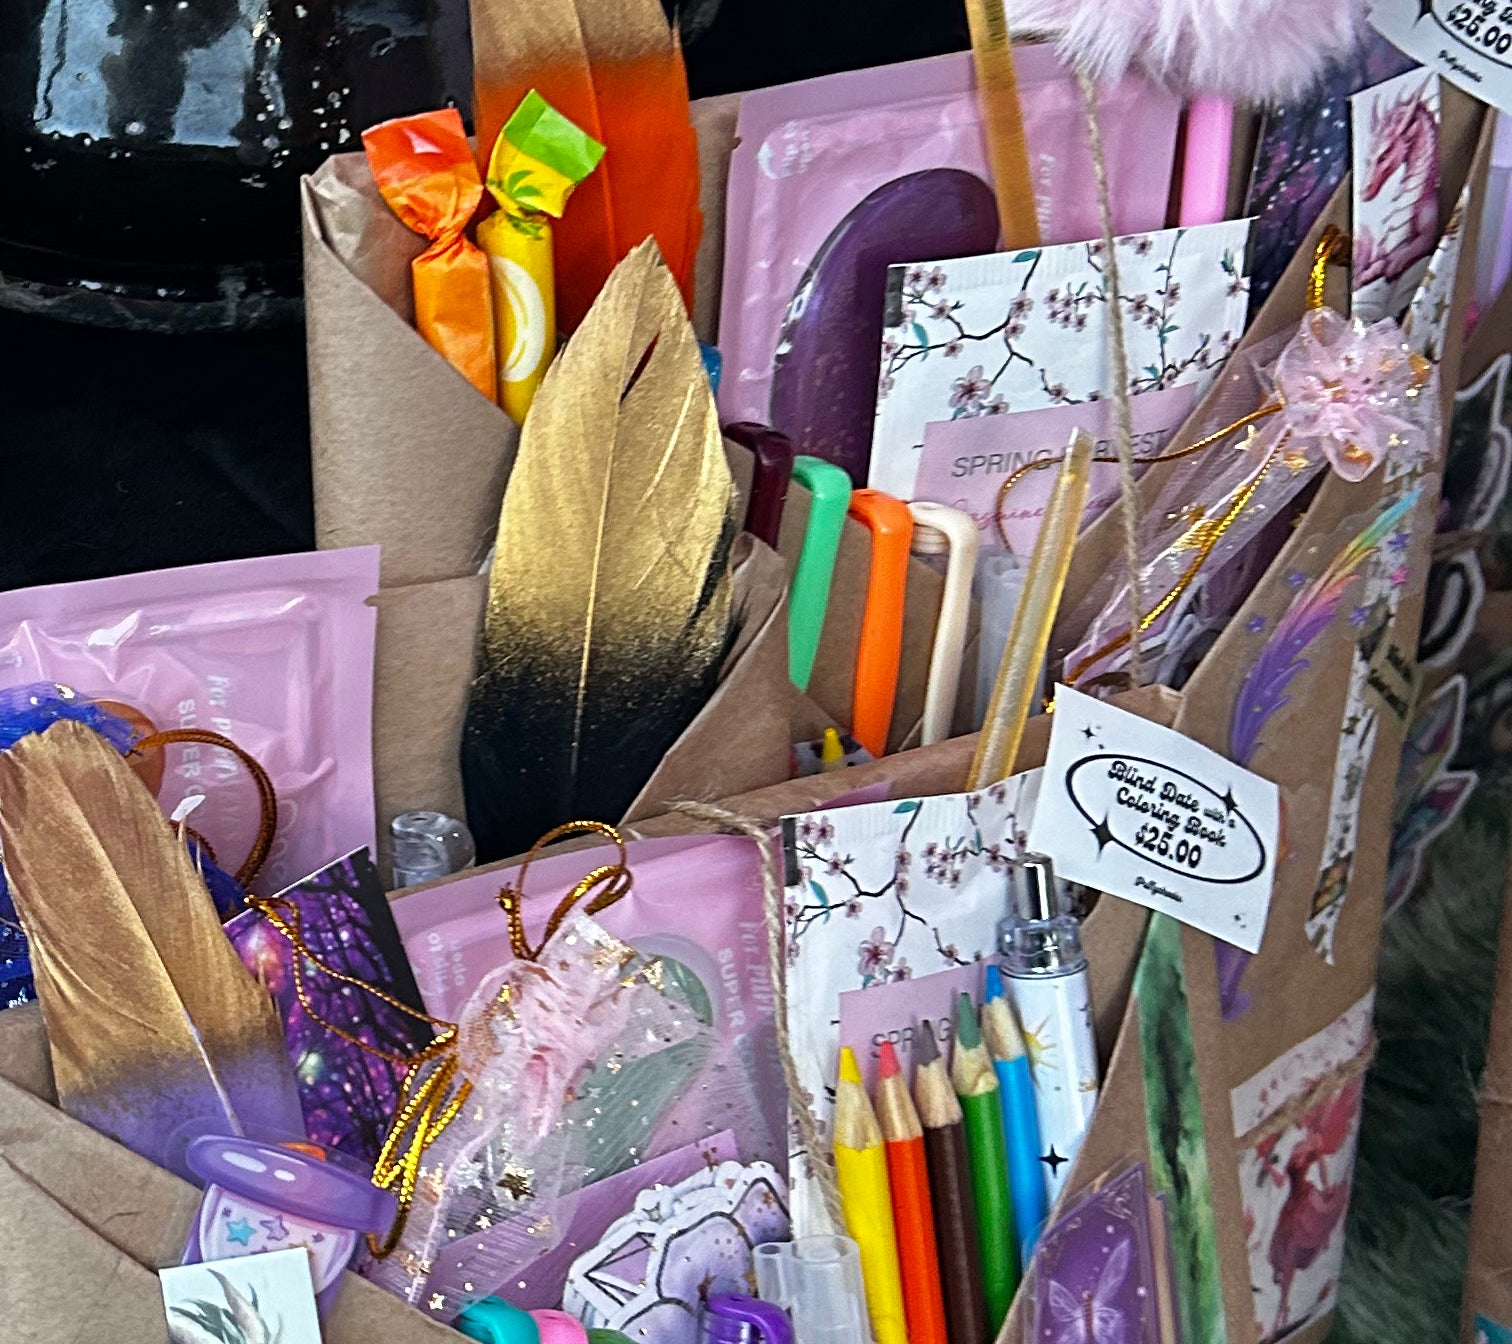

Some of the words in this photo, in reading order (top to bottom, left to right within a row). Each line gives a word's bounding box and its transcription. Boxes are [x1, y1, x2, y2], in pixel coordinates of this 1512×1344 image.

[1108, 761, 1157, 794] Blind
[1160, 782, 1199, 812] Date
[1117, 787, 1180, 832] Coloring
[1184, 816, 1226, 847] Book
[1135, 822, 1202, 869] $25.00
